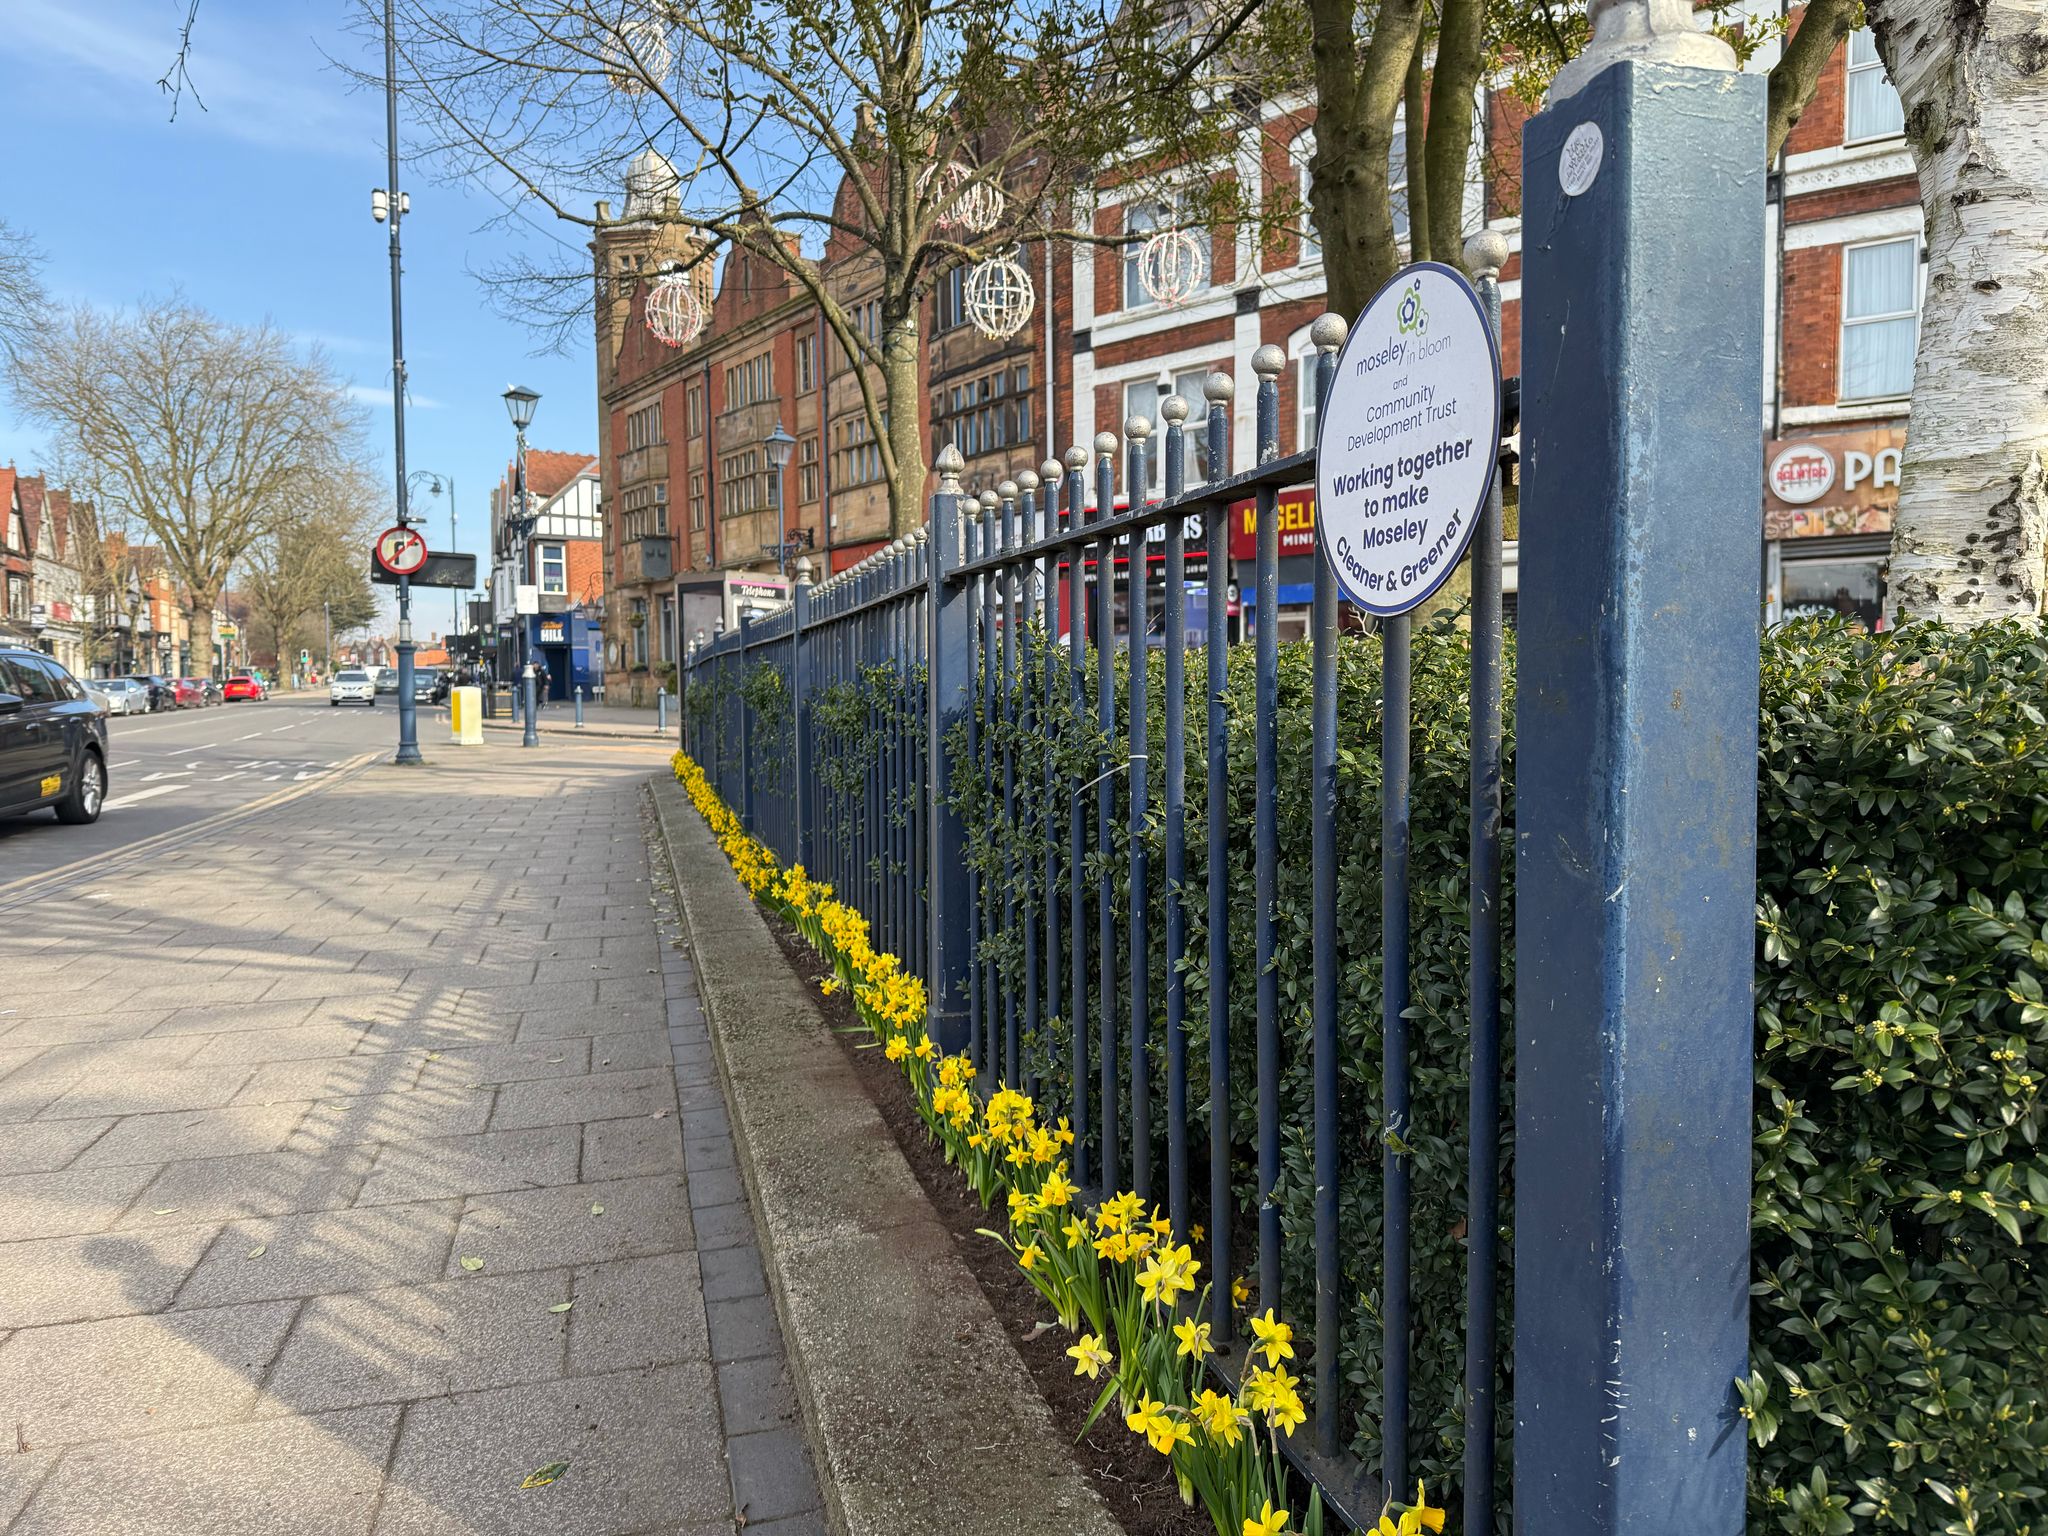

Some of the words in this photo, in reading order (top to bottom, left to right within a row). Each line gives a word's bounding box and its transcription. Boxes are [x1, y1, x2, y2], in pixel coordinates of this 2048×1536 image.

[1356, 336, 1407, 377] moseley
[1407, 344, 1415, 367] in
[1418, 335, 1451, 362] bloom
[1393, 375, 1408, 391] and
[1366, 385, 1436, 423] Community
[1347, 411, 1423, 452] Development
[1425, 398, 1457, 424] Trust
[1333, 463, 1394, 497] Working
[1397, 438, 1473, 481] together
[1244, 501, 1314, 535] MSEL
[1364, 496, 1380, 518] to
[1382, 485, 1429, 514] make
[1283, 533, 1314, 547] MINI
[1337, 536, 1384, 591] Cleaner
[1386, 570, 1398, 591] &
[1400, 508, 1462, 586] Greener
[1362, 519, 1428, 549] Moseley
[541, 629, 564, 642] HILL
